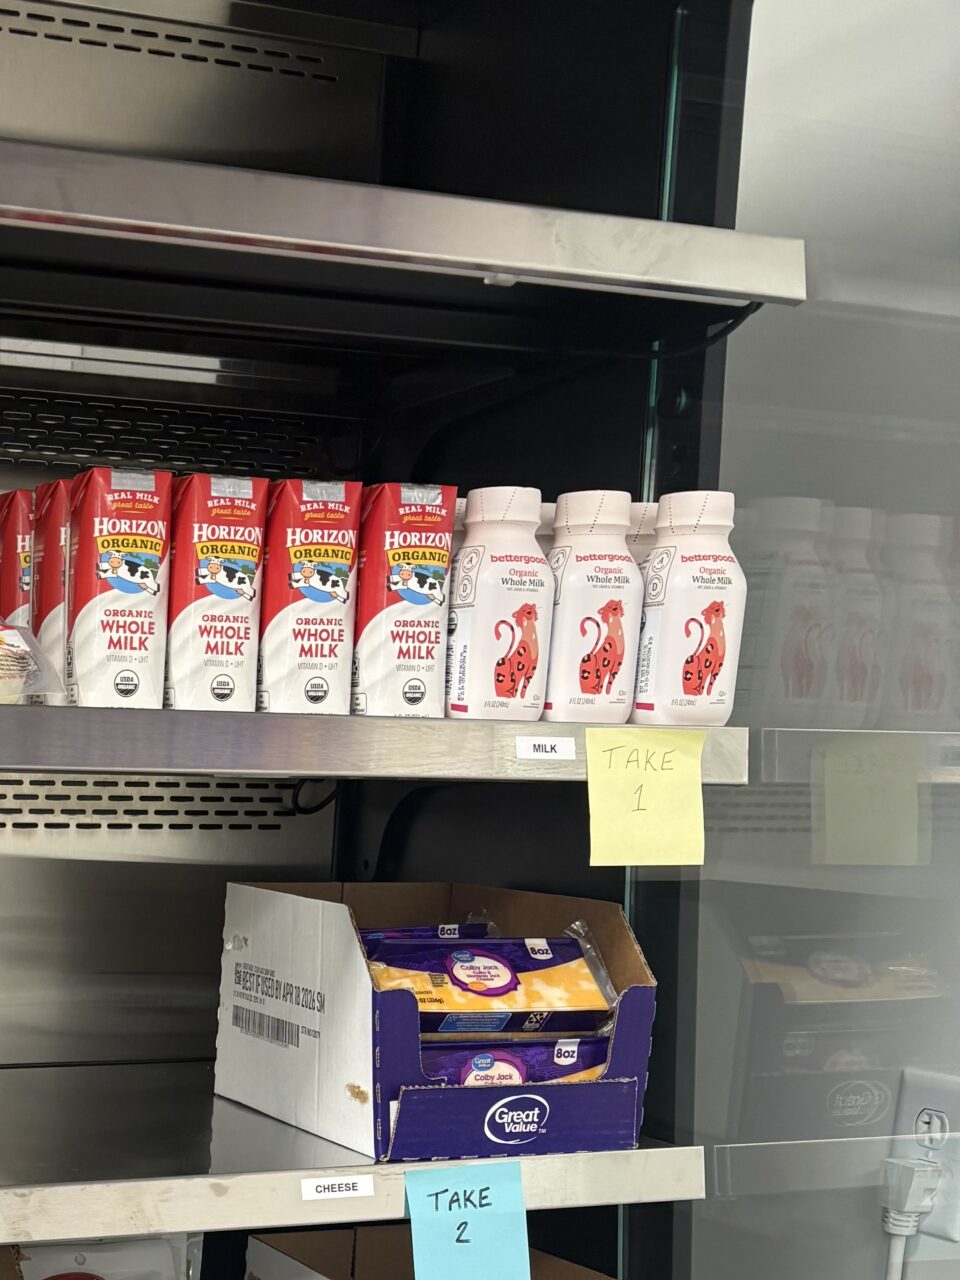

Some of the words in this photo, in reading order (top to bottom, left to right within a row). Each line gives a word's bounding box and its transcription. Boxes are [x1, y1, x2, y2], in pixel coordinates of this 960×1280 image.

[106, 492, 132, 502] REAL
[136, 492, 160, 504] MILK
[93, 517, 167, 541] HORIZON
[192, 523, 263, 546] HORIZON
[101, 538, 161, 551] ORGANIC
[286, 528, 357, 548] HORIZON
[384, 531, 452, 551] HORIZON
[200, 545, 257, 558] ORGANIC
[294, 548, 351, 561] ORGANIC
[392, 550, 447, 563] ORGANIC
[594, 566, 624, 576] Organic
[586, 575, 612, 584] Whole
[614, 576, 630, 584] Milk
[104, 609, 153, 618] ORGANIC
[202, 614, 249, 624] ORGANIC
[101, 620, 155, 636] WHOLE
[198, 625, 250, 641] WHOLE
[292, 629, 344, 642] WHOLE
[390, 631, 440, 644] WHOLE
[108, 636, 149, 651] MILK
[205, 641, 244, 656] MILK
[299, 644, 338, 658] MILK
[397, 646, 435, 660] MILK
[533, 744, 557, 753] MILK
[602, 745, 676, 771] TAKE
[632, 784, 646, 812] 1
[439, 926, 457, 936] 8oz
[530, 947, 550, 956] 8oz
[242, 971, 255, 992] BEST
[255, 974, 260, 994] IF
[261, 975, 274, 998] USED
[275, 979, 282, 1000] BY
[282, 982, 293, 1005] APR
[301, 987, 315, 1011] 2026
[317, 992, 325, 1014] SM
[555, 1048, 575, 1059] 8oz
[474, 1073, 494, 1082] Colby
[495, 1107, 540, 1124] Great
[504, 1122, 538, 1133] Value
[315, 1181, 359, 1193] CHEESE
[427, 1187, 492, 1212] TAKE
[455, 1221, 471, 1243] 2
